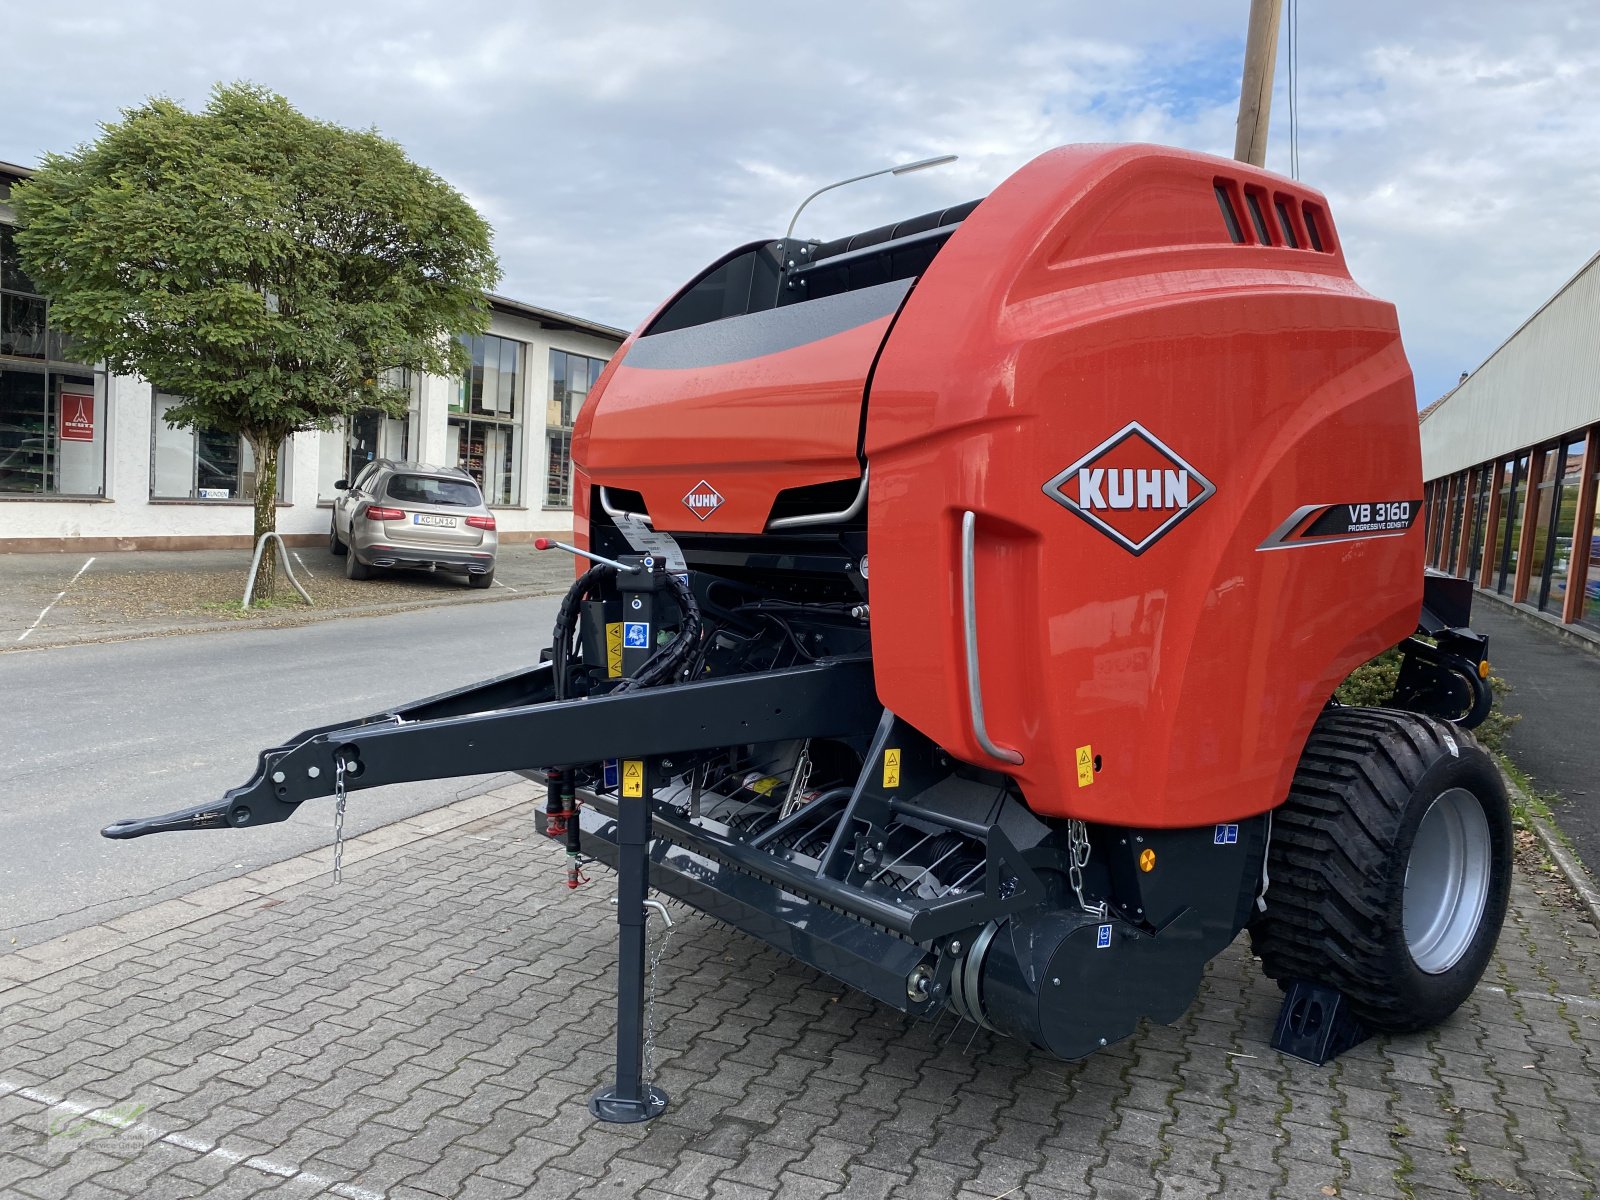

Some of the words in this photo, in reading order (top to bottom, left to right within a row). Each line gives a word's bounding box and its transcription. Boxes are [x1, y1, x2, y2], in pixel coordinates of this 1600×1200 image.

[1079, 468, 1188, 508] KUHN
[689, 494, 718, 507] KUHN
[1348, 504, 1371, 523] VB
[1375, 502, 1410, 521] 3160
[1348, 522, 1386, 532] PROGRESSIVE
[1386, 521, 1409, 529] DENSITY
